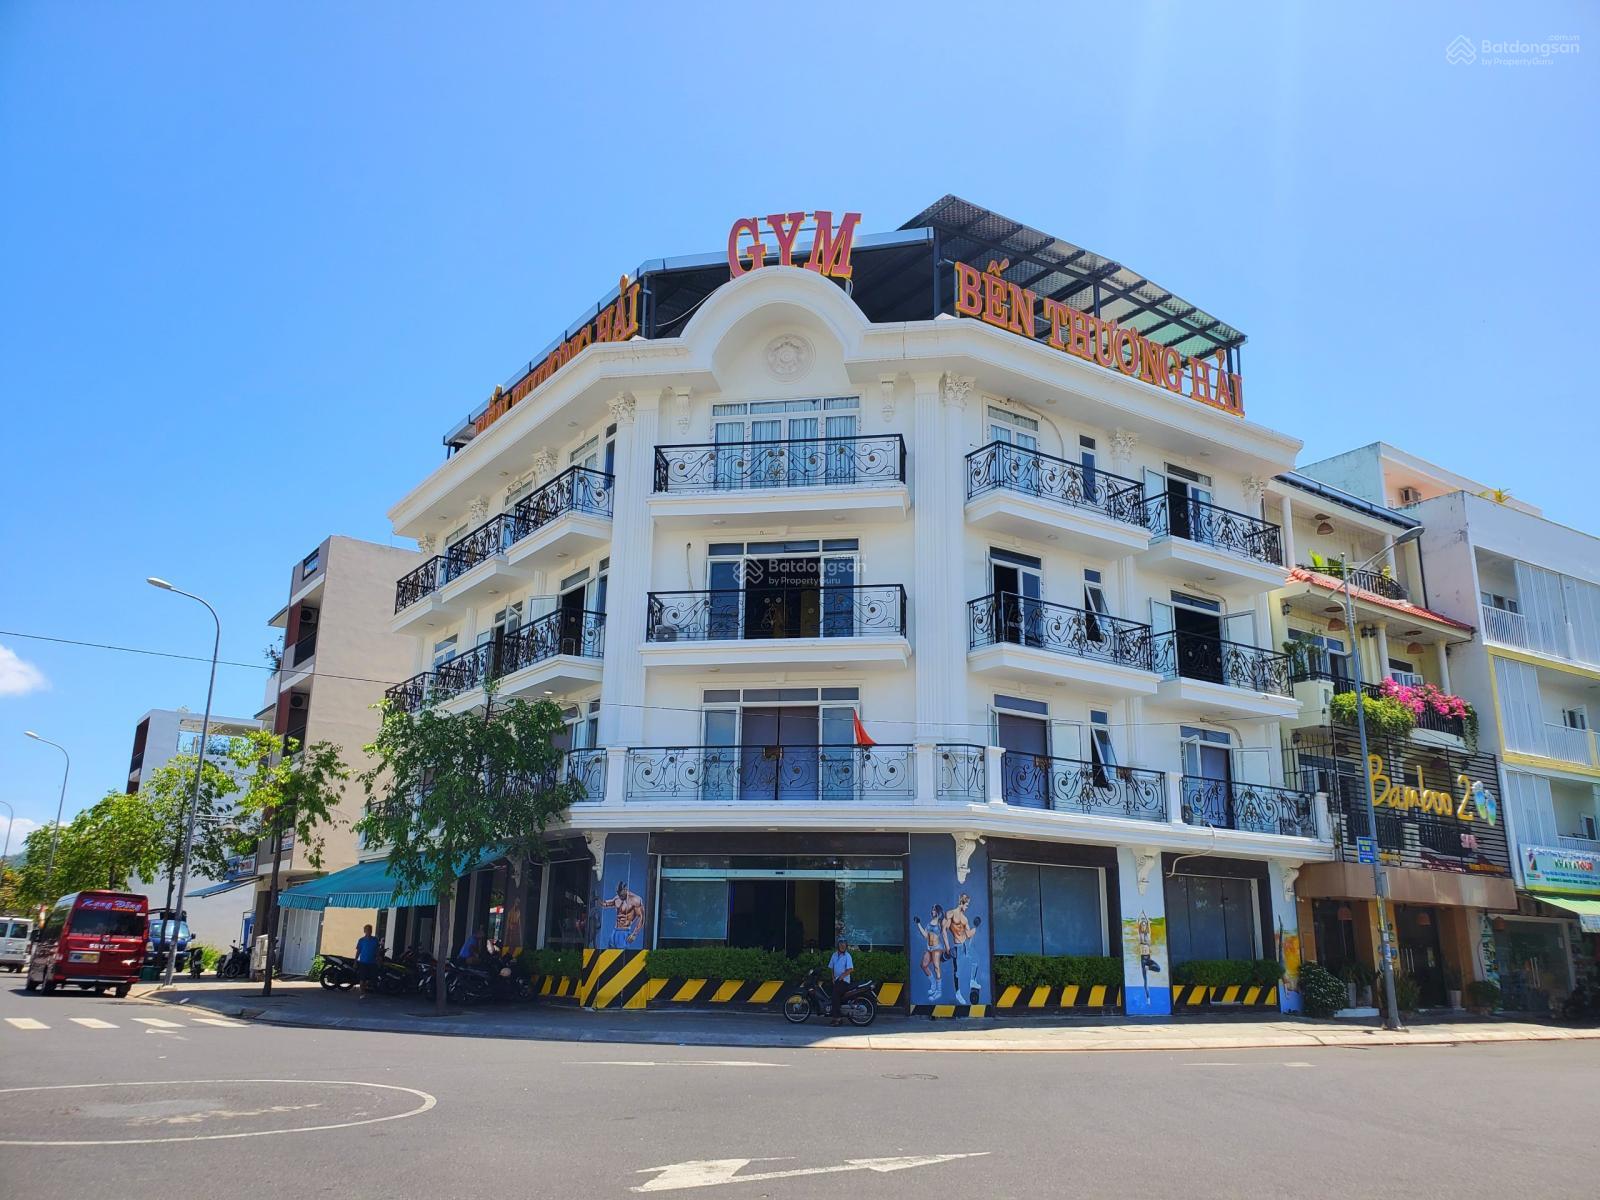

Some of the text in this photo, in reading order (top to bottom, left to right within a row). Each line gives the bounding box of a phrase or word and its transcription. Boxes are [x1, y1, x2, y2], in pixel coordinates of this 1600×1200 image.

[728, 210, 862, 279] GYM
[955, 258, 1245, 418] BẾN THƯƠNG HẢI
[1368, 753, 1475, 821] Bamboo 2
